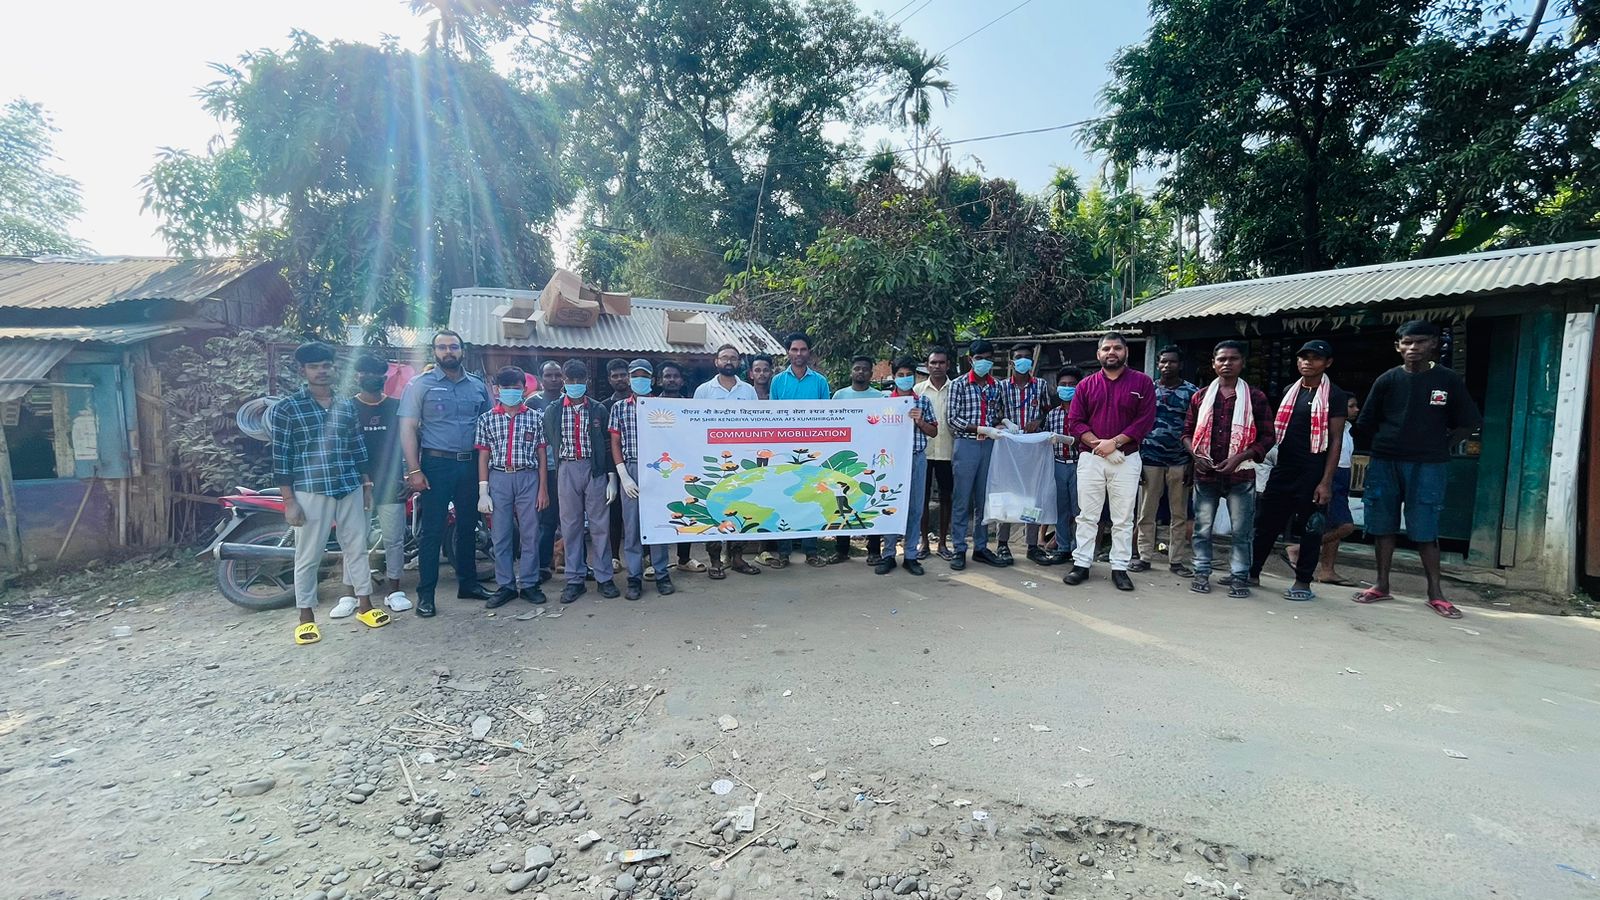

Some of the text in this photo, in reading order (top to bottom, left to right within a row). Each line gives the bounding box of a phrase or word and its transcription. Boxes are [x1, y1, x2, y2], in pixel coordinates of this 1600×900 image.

[881, 414, 904, 424] SHRI
[709, 429, 847, 439] COMMUNITY MOBILIZATION
